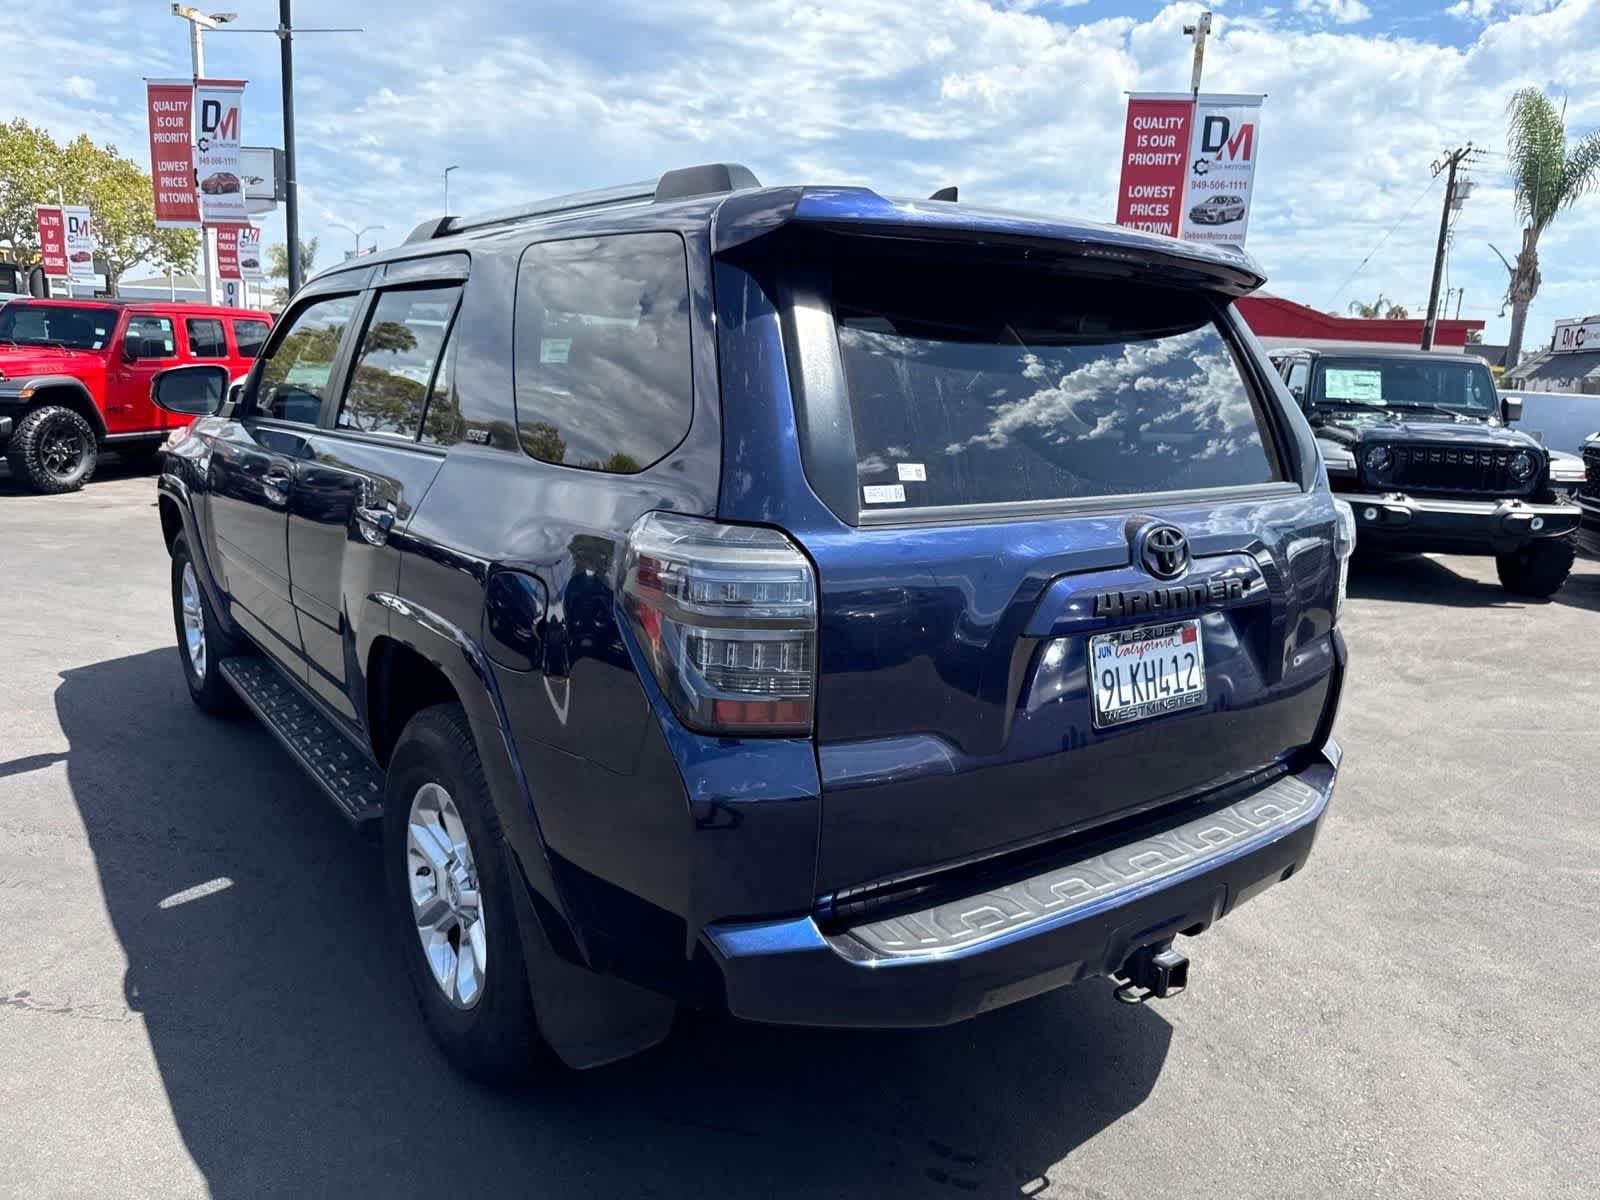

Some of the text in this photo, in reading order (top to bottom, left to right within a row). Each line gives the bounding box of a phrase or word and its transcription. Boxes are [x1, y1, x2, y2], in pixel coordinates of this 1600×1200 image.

[152, 101, 188, 113] QUALITY
[157, 117, 184, 127] IS OUR
[1133, 117, 1185, 130] QUALITY
[153, 132, 189, 143] PRIORITY
[1137, 135, 1176, 148] IS OUR
[1128, 153, 1182, 166] PRIORITY
[158, 161, 189, 172] LOWEST
[160, 177, 188, 188] PRICES
[1191, 181, 1248, 191] 949-506-1111
[159, 193, 194, 204] IN TOWN
[1128, 185, 1175, 199] LOWEST
[1130, 204, 1169, 217] PRICES
[1137, 222, 1172, 235] TOWN
[1121, 626, 1175, 643] LEXUS
[1097, 645, 1112, 659] JUN
[1114, 636, 1181, 660] California
[1101, 652, 1198, 710] 9LKH412
[1103, 693, 1202, 721] WESTMINSTER
